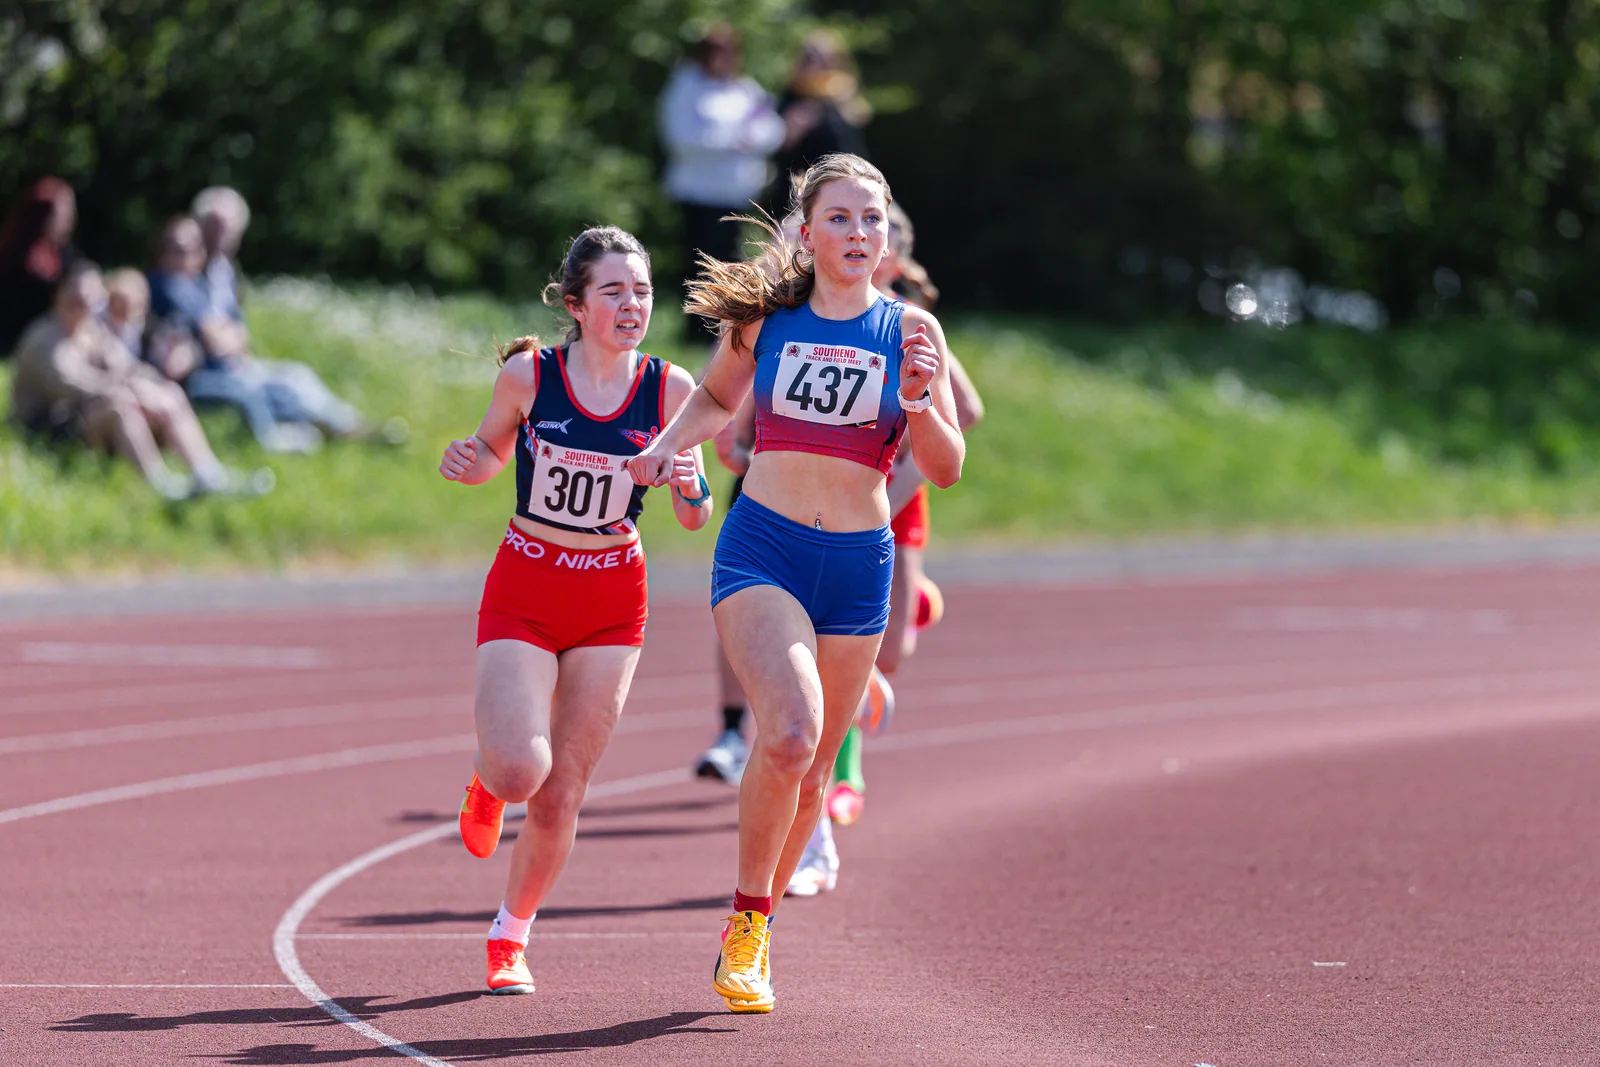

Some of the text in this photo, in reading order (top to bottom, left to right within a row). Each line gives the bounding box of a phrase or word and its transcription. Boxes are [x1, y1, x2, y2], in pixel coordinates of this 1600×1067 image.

[805, 354, 821, 362] TRACK
[813, 346, 857, 359] SOUTHEND
[785, 362, 868, 417] 437
[564, 450, 609, 466] SOUTHEND
[544, 466, 613, 520] 301
[555, 550, 621, 570] NIKE
